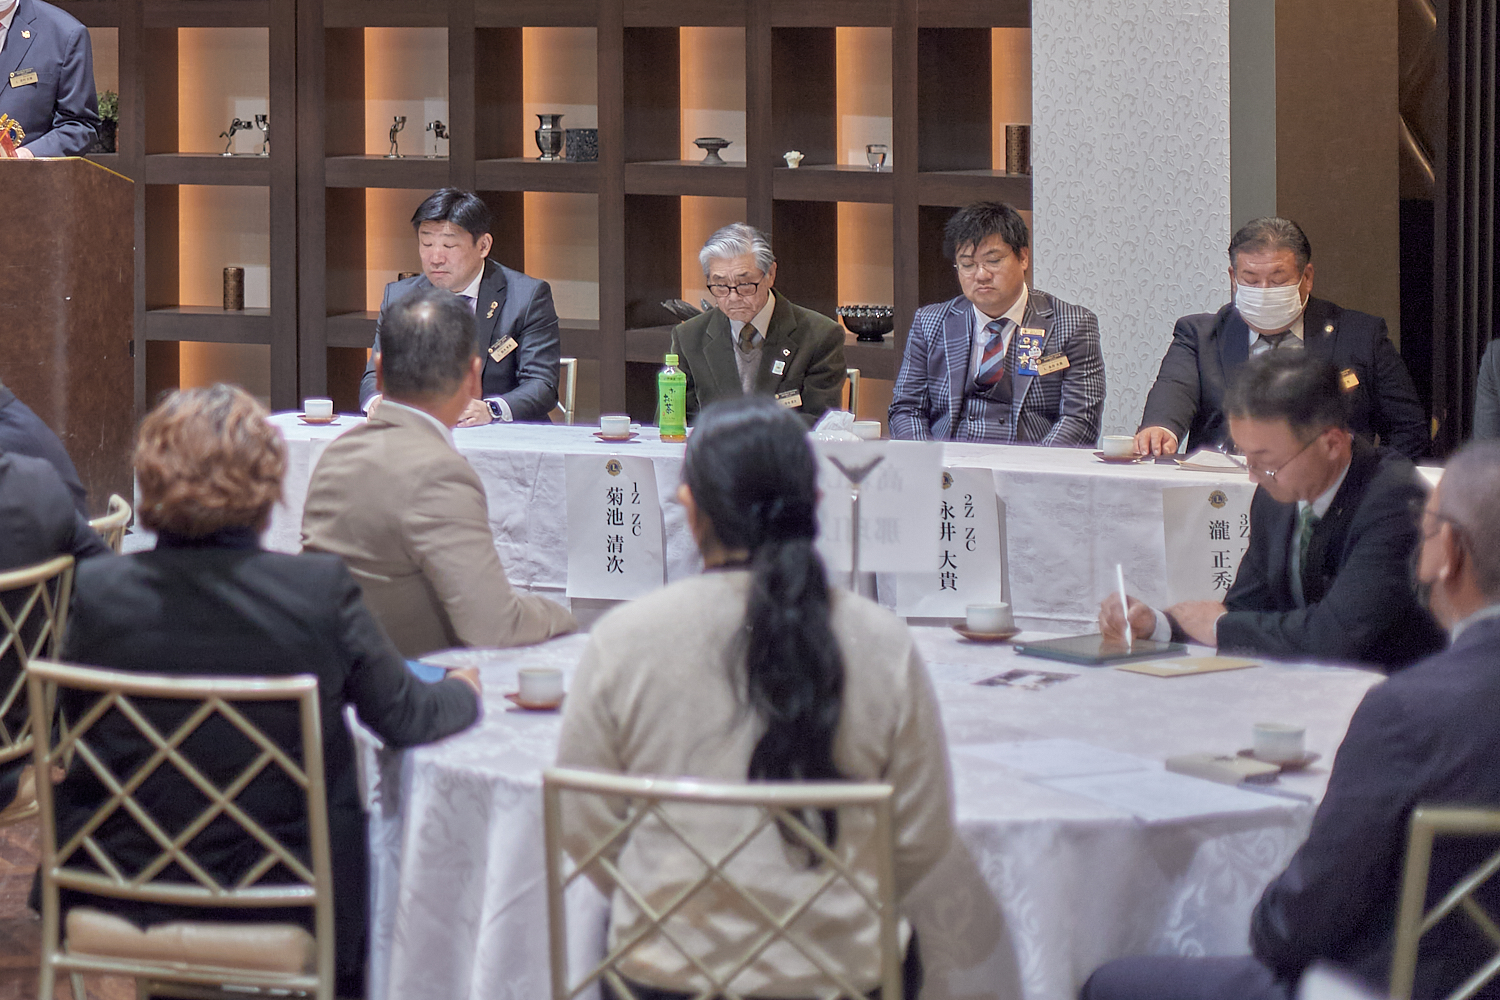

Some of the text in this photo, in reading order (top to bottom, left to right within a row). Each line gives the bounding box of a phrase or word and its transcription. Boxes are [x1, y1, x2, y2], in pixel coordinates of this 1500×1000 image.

[606, 486, 624, 574] 菊池 清次
[631, 513, 642, 537] ZC
[939, 501, 958, 591] 永井 大貴
[965, 527, 977, 552] ZC
